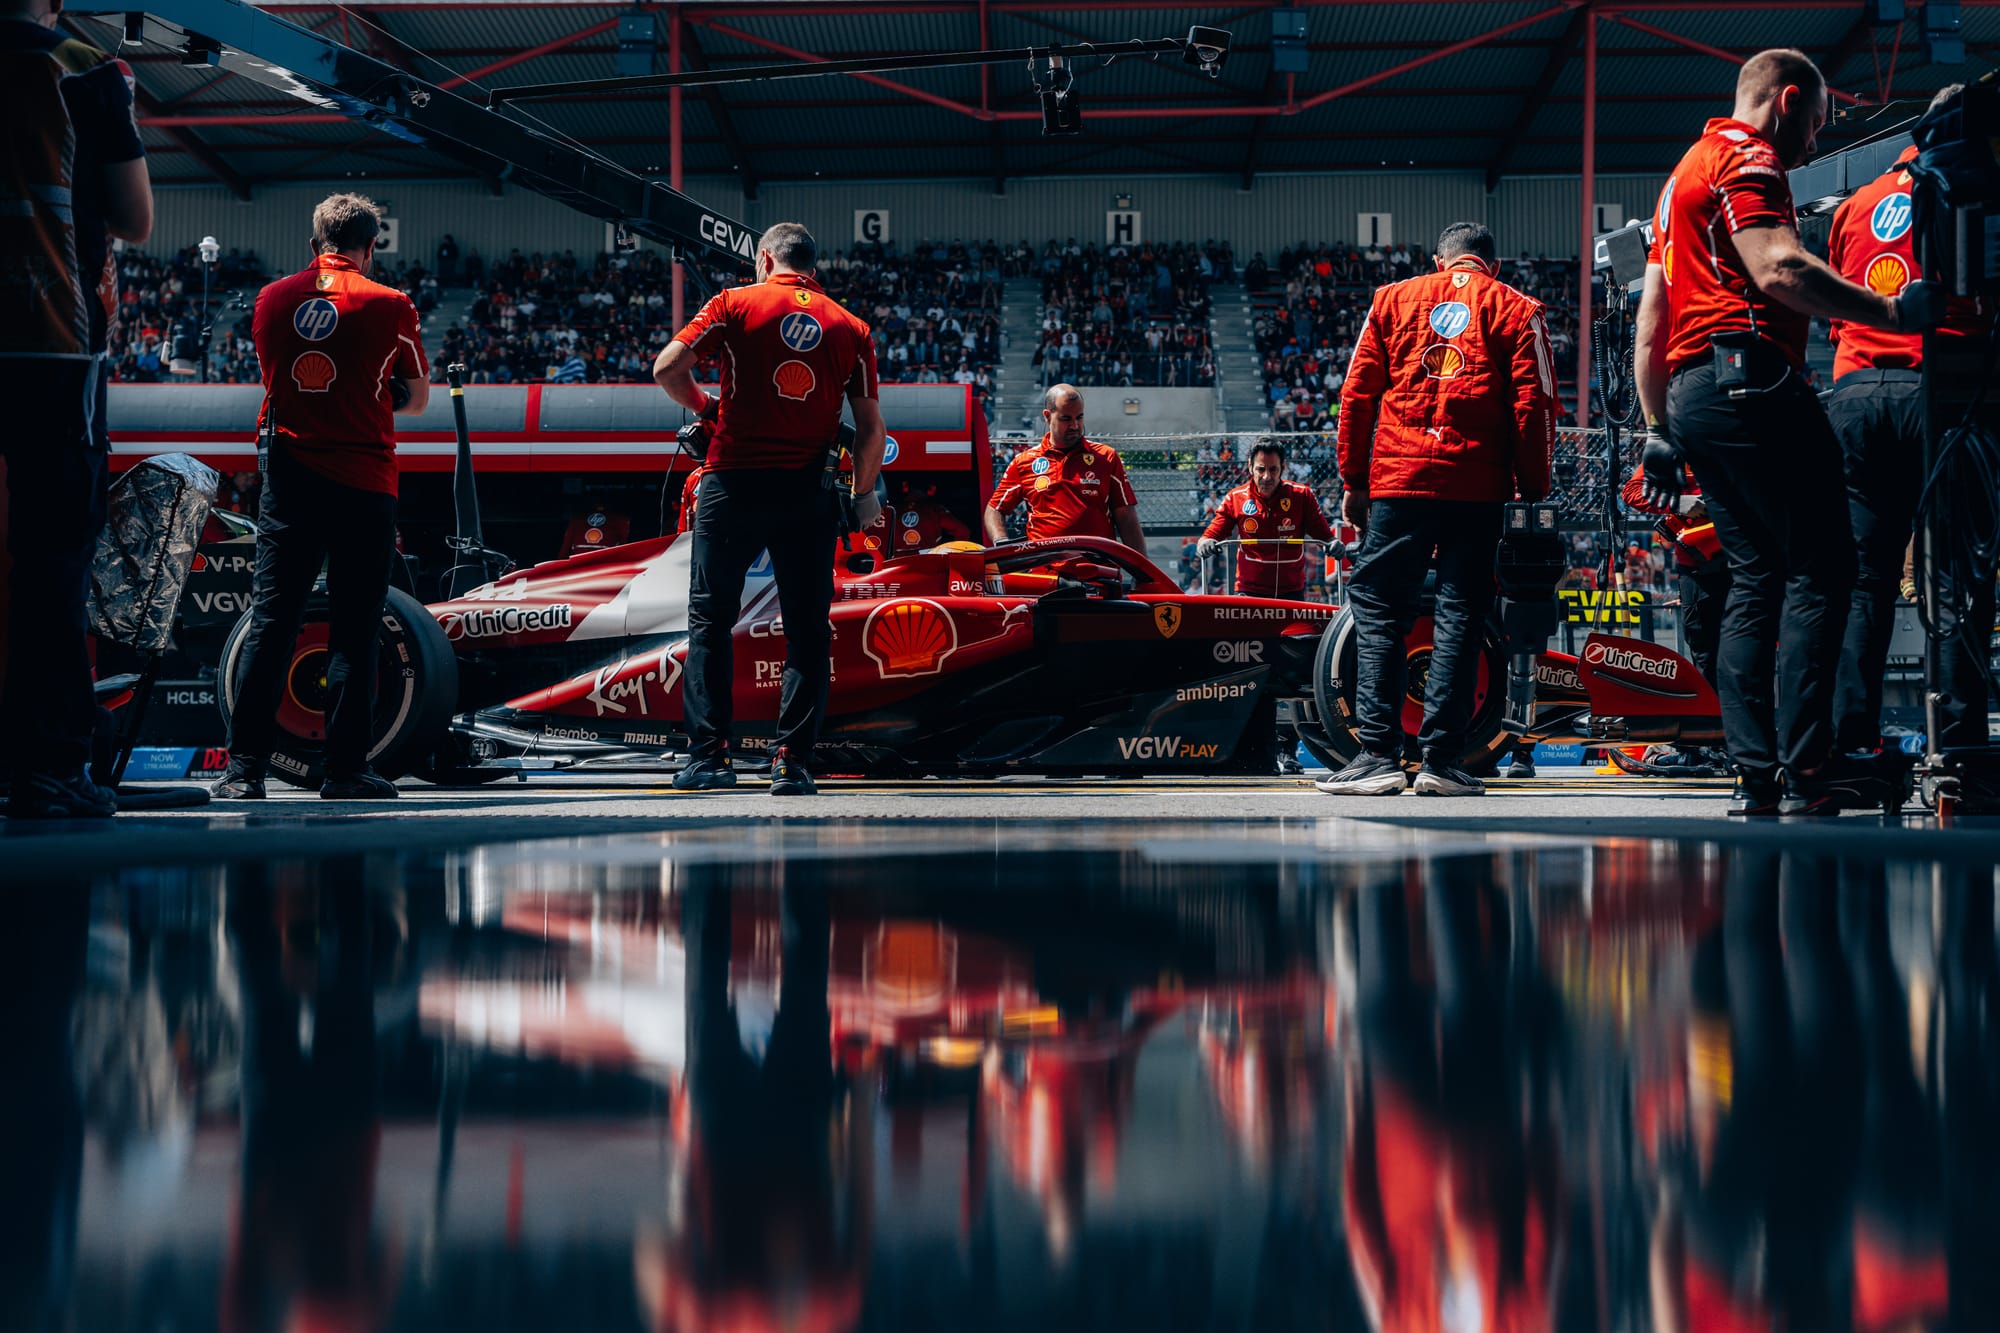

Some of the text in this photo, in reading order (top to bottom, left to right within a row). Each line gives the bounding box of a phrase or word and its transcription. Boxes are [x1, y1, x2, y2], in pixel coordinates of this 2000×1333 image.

[862, 212, 881, 241] G
[1874, 194, 1912, 241] hp
[1115, 214, 1132, 243] H
[298, 298, 335, 340] hp
[1433, 302, 1468, 338] hp
[785, 312, 819, 351] hp
[1034, 457, 1048, 473] hp
[1244, 500, 1257, 515] hp
[902, 511, 918, 527] hp
[841, 583, 901, 601] IBM
[950, 580, 983, 592] aws
[465, 603, 572, 637] UniCredit
[1214, 607, 1286, 619] RICHARD
[1604, 646, 1677, 679] UniCredit
[1176, 682, 1247, 702] ambipar
[545, 724, 599, 741] brembo
[624, 732, 667, 745] MAHLE
[1118, 736, 1218, 760] VGW PLAY
[1540, 751, 1577, 759] STREAMING
[151, 754, 175, 762] NOW
